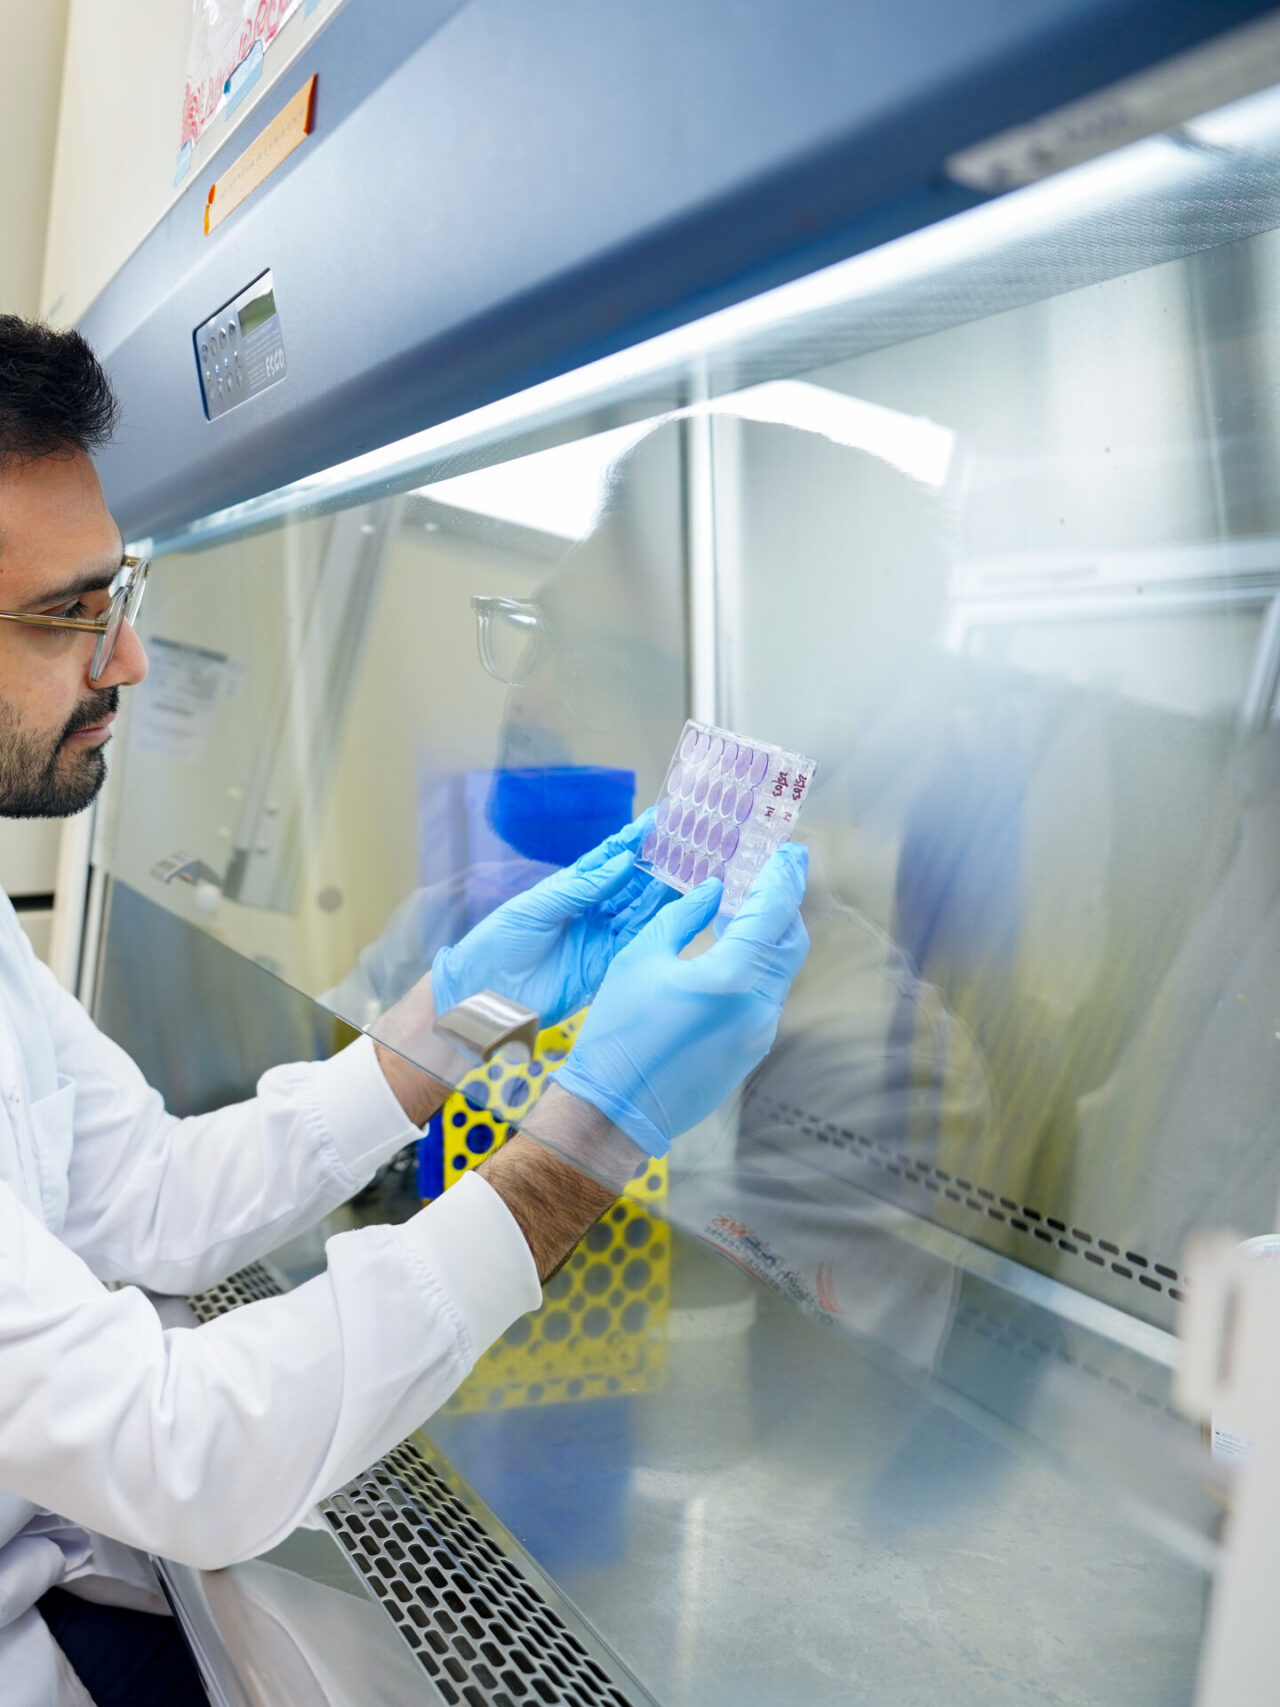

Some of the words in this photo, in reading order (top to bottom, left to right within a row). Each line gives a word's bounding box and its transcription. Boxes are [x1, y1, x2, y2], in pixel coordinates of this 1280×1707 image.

[772, 772, 788, 796] 25/03
[792, 774, 807, 800] 25/03
[765, 806, 775, 817] 14
